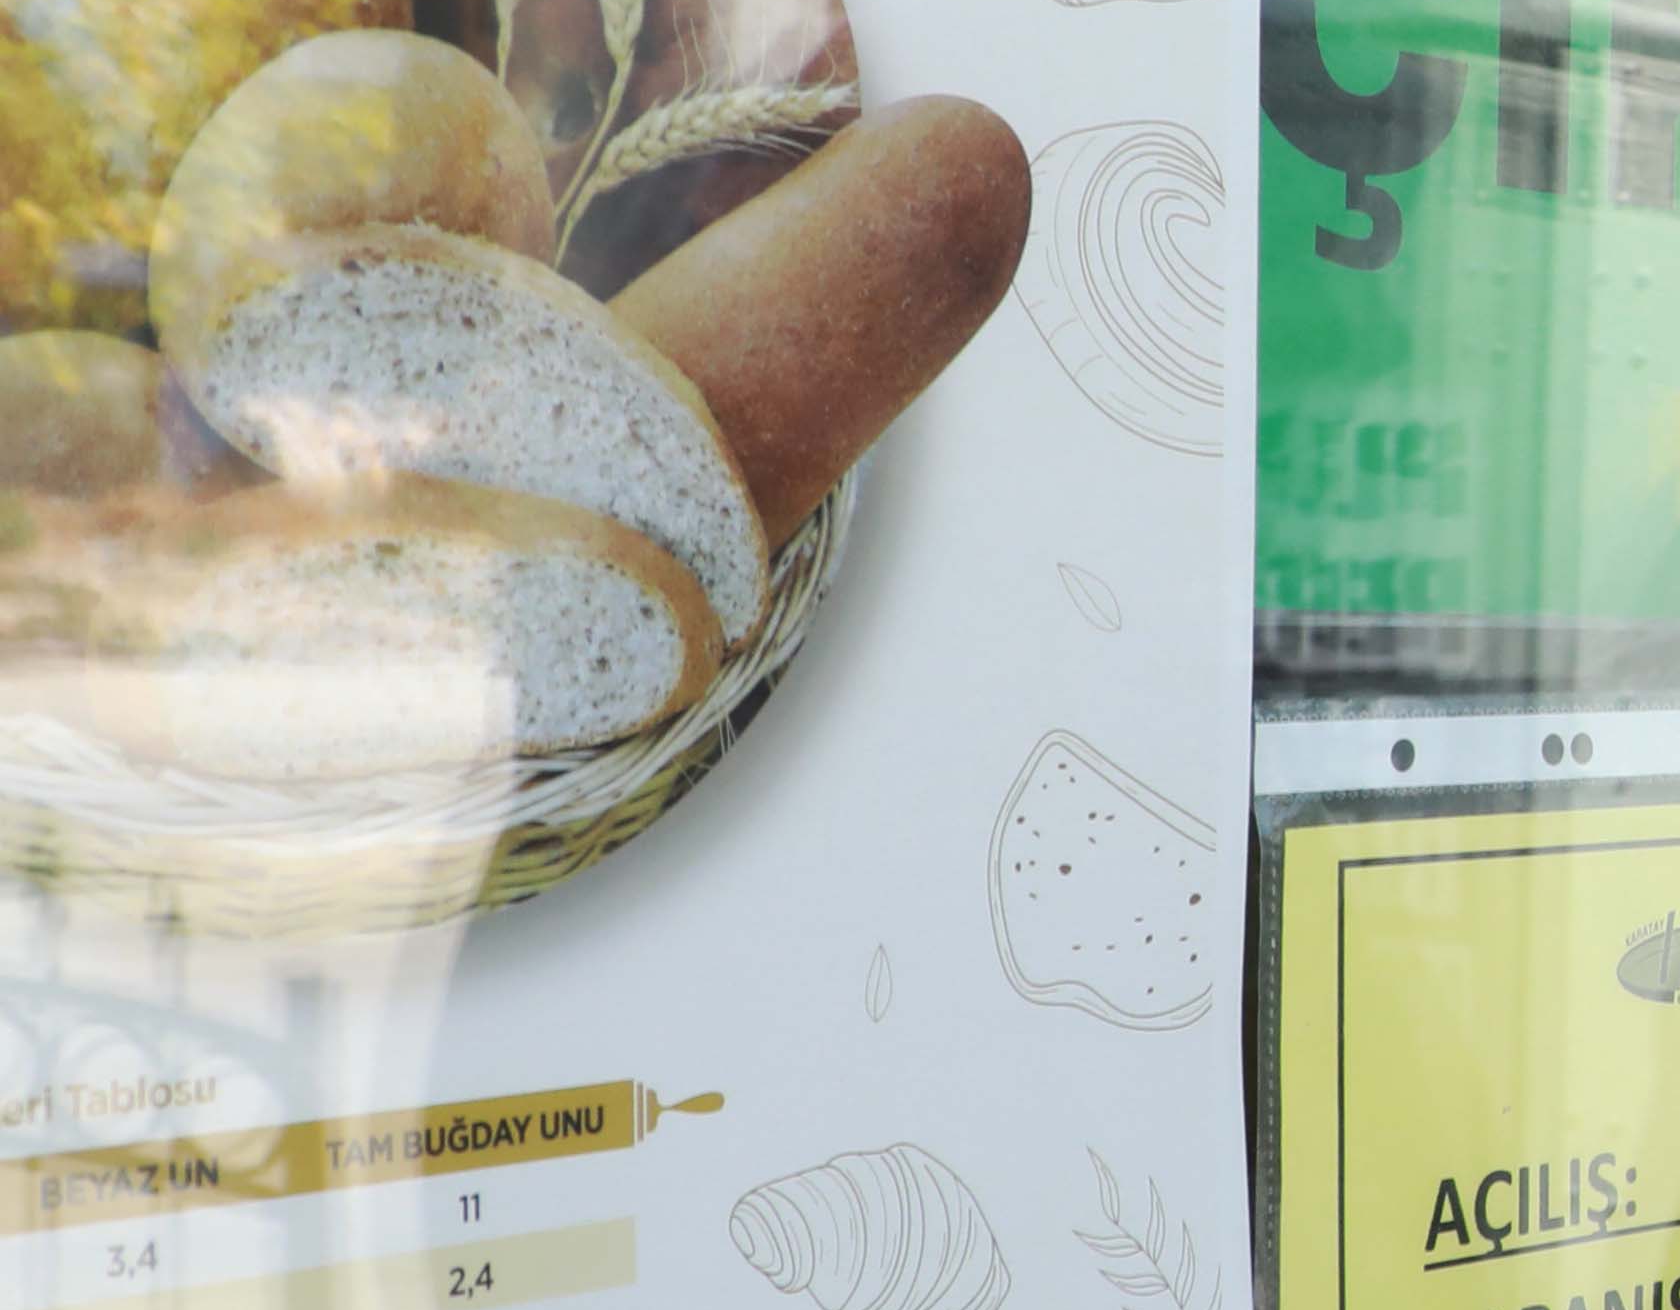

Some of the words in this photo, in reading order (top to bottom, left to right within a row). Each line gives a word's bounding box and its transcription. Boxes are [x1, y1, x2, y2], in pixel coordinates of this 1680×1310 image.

[65, 1074, 218, 1118] Tablosu
[39, 1164, 160, 1212] BEYAZ
[168, 1157, 221, 1191] UN
[325, 1135, 394, 1172] TAM
[403, 1114, 532, 1160] BUĞDAY
[538, 1104, 606, 1141] UNU
[106, 1242, 159, 1280] 3,4
[459, 1193, 482, 1224] 11
[1424, 1152, 1639, 1256] AÇILIŞ:
[448, 1263, 495, 1301] 2,4
